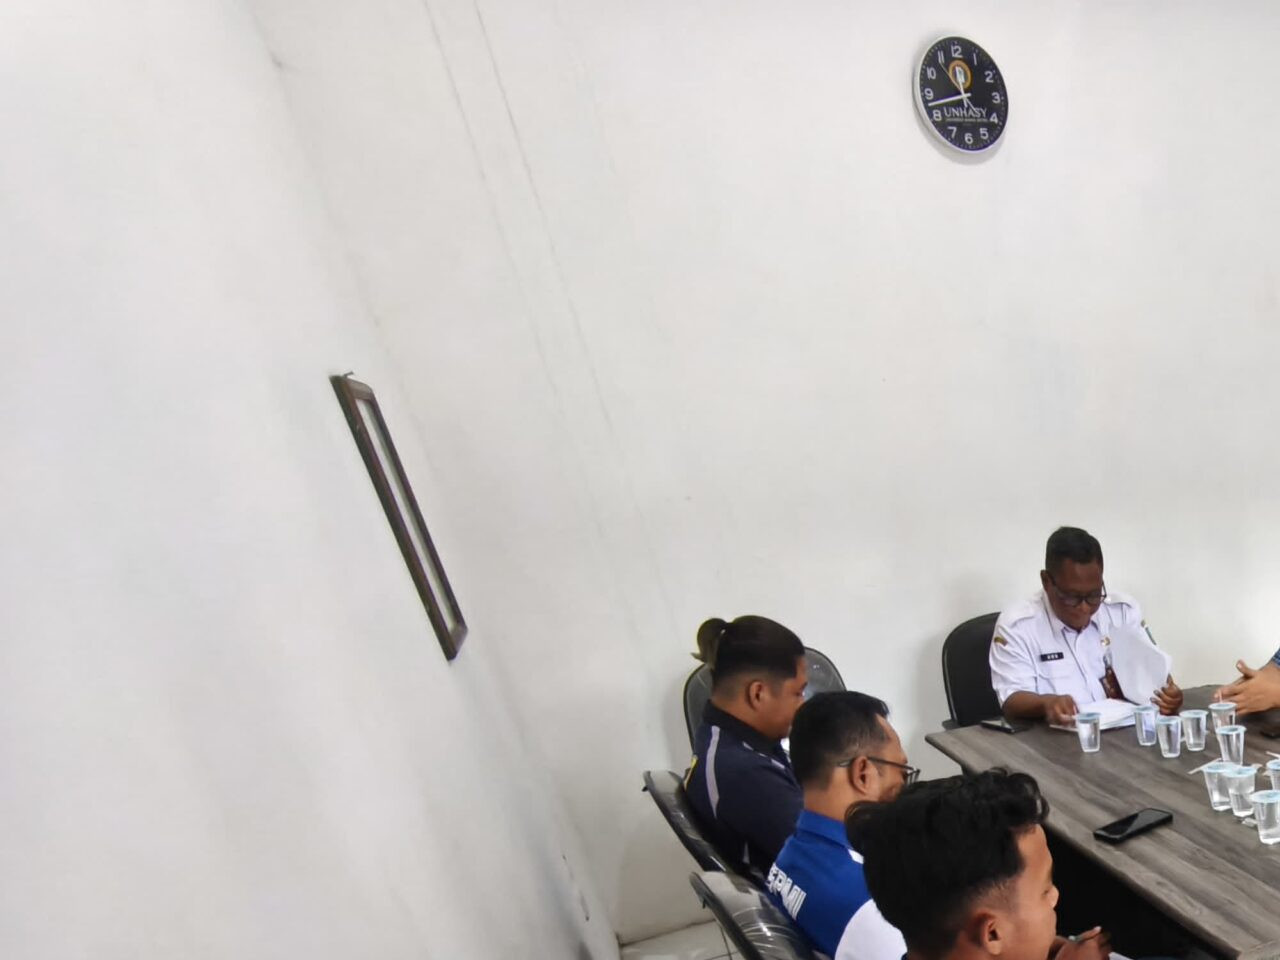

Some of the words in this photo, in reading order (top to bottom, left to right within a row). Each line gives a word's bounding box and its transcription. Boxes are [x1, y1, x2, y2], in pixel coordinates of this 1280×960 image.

[951, 45, 963, 58] 12
[973, 52, 978, 66] 1
[926, 66, 937, 80] 10
[984, 70, 994, 83] 2
[924, 88, 934, 100] 9
[991, 92, 1001, 104] 3
[932, 109, 942, 121] 8
[943, 106, 987, 118] UNHASY
[989, 112, 999, 124] 4
[947, 126, 957, 138] 7
[979, 127, 989, 140] 5
[964, 133, 974, 145] 6
